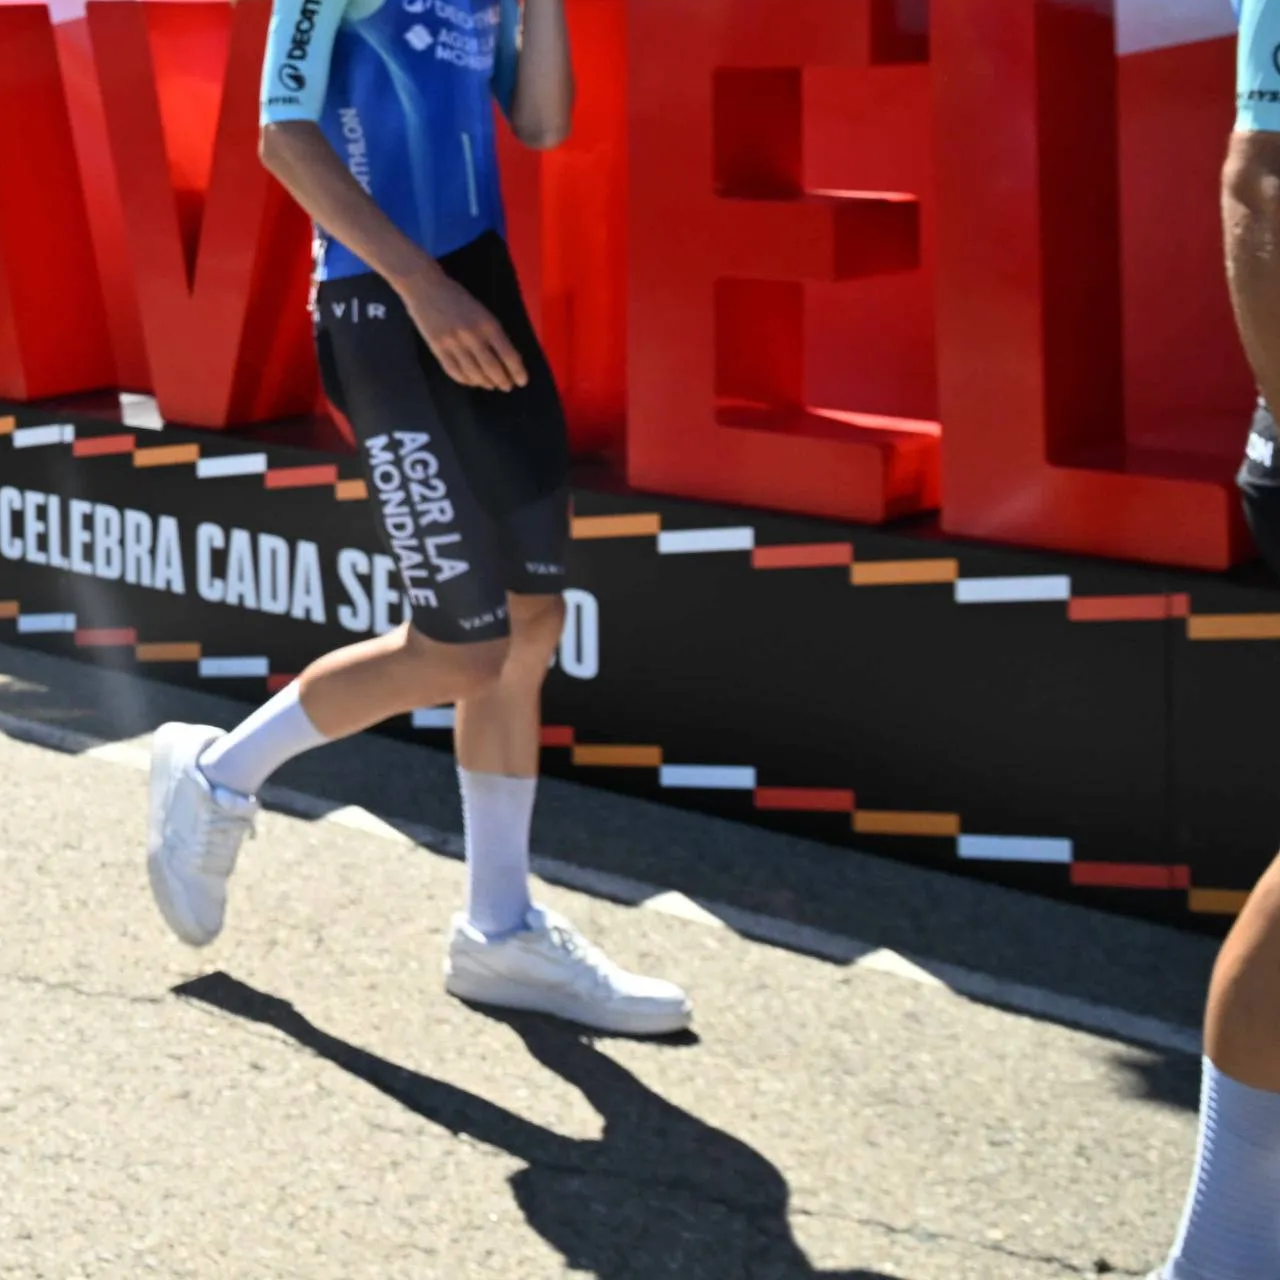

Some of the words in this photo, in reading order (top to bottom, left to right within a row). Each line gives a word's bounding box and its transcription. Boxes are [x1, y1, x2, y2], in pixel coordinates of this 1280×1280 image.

[364, 434, 438, 609] MONDIALE
[392, 429, 455, 527] AG2R
[196, 521, 327, 625] CADA
[423, 533, 471, 584] LA
